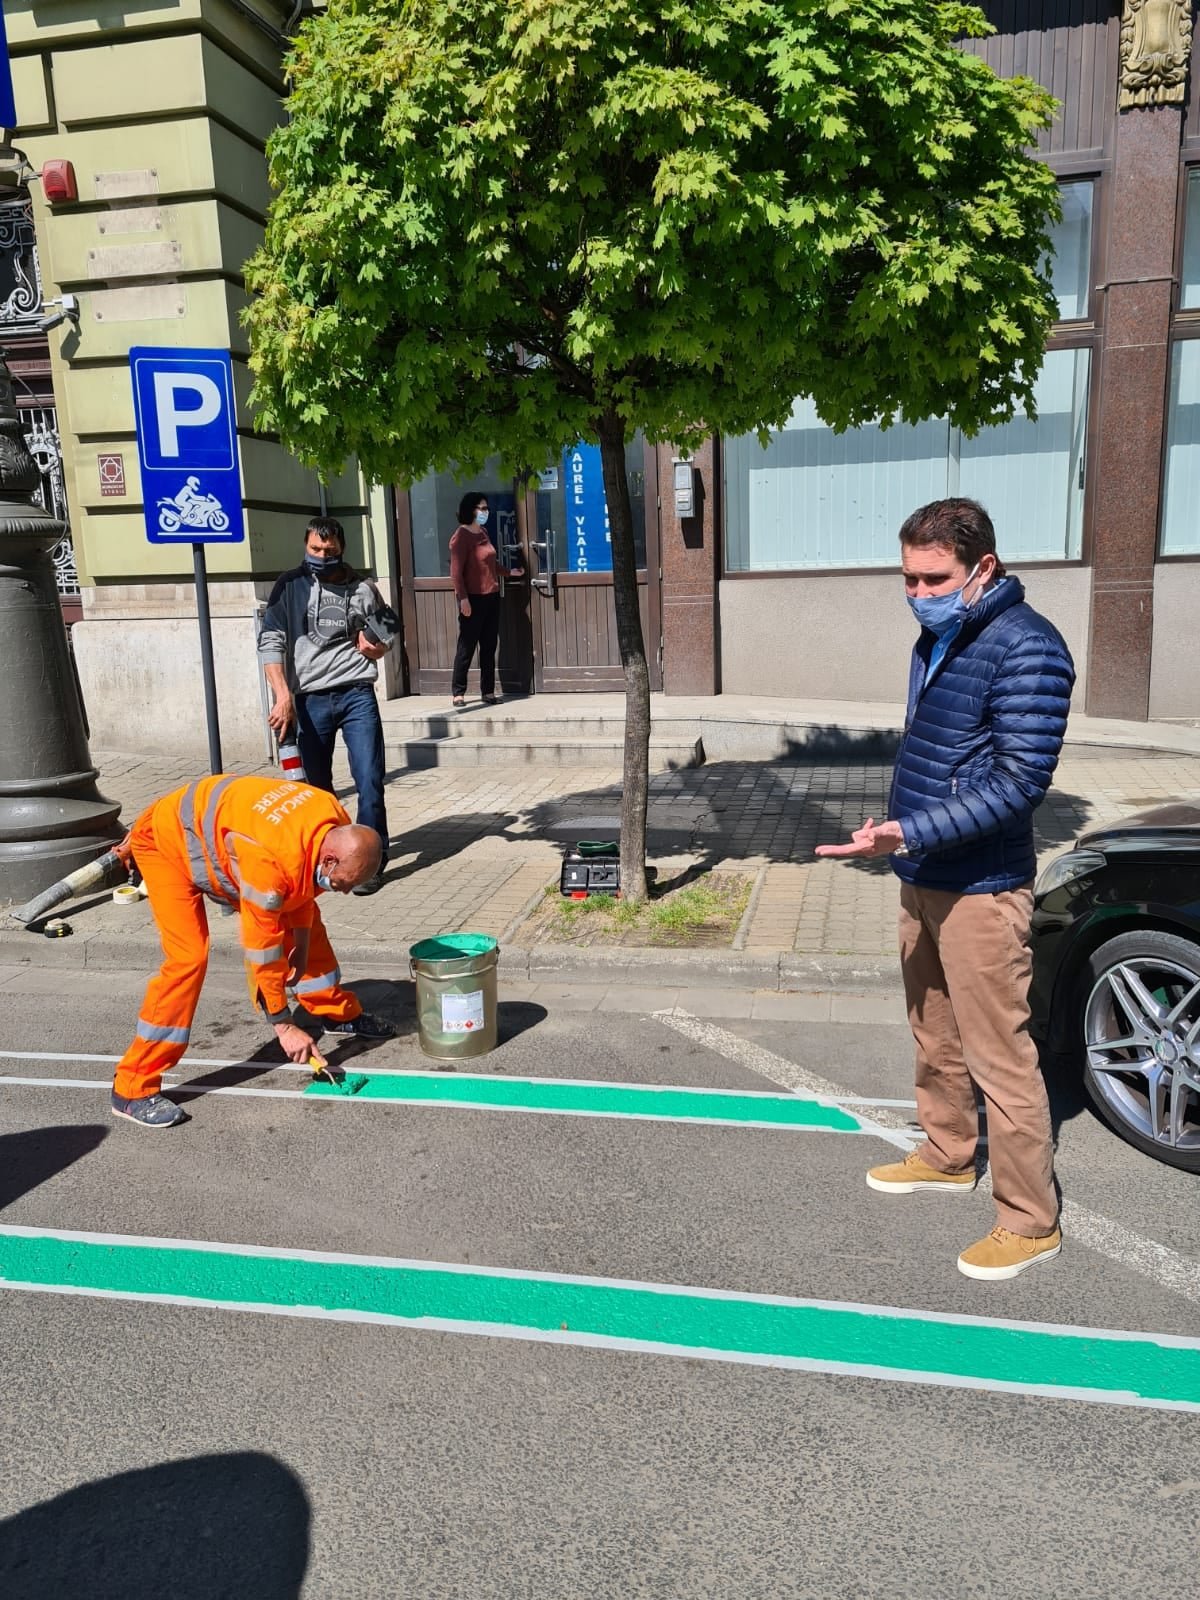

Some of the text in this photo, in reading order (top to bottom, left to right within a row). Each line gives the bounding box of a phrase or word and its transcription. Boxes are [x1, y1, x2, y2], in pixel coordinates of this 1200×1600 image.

[153, 371, 222, 457] P
[572, 452, 583, 504] AUREL
[252, 783, 299, 814] RUTIERE
[265, 789, 316, 825] MARCAJE
